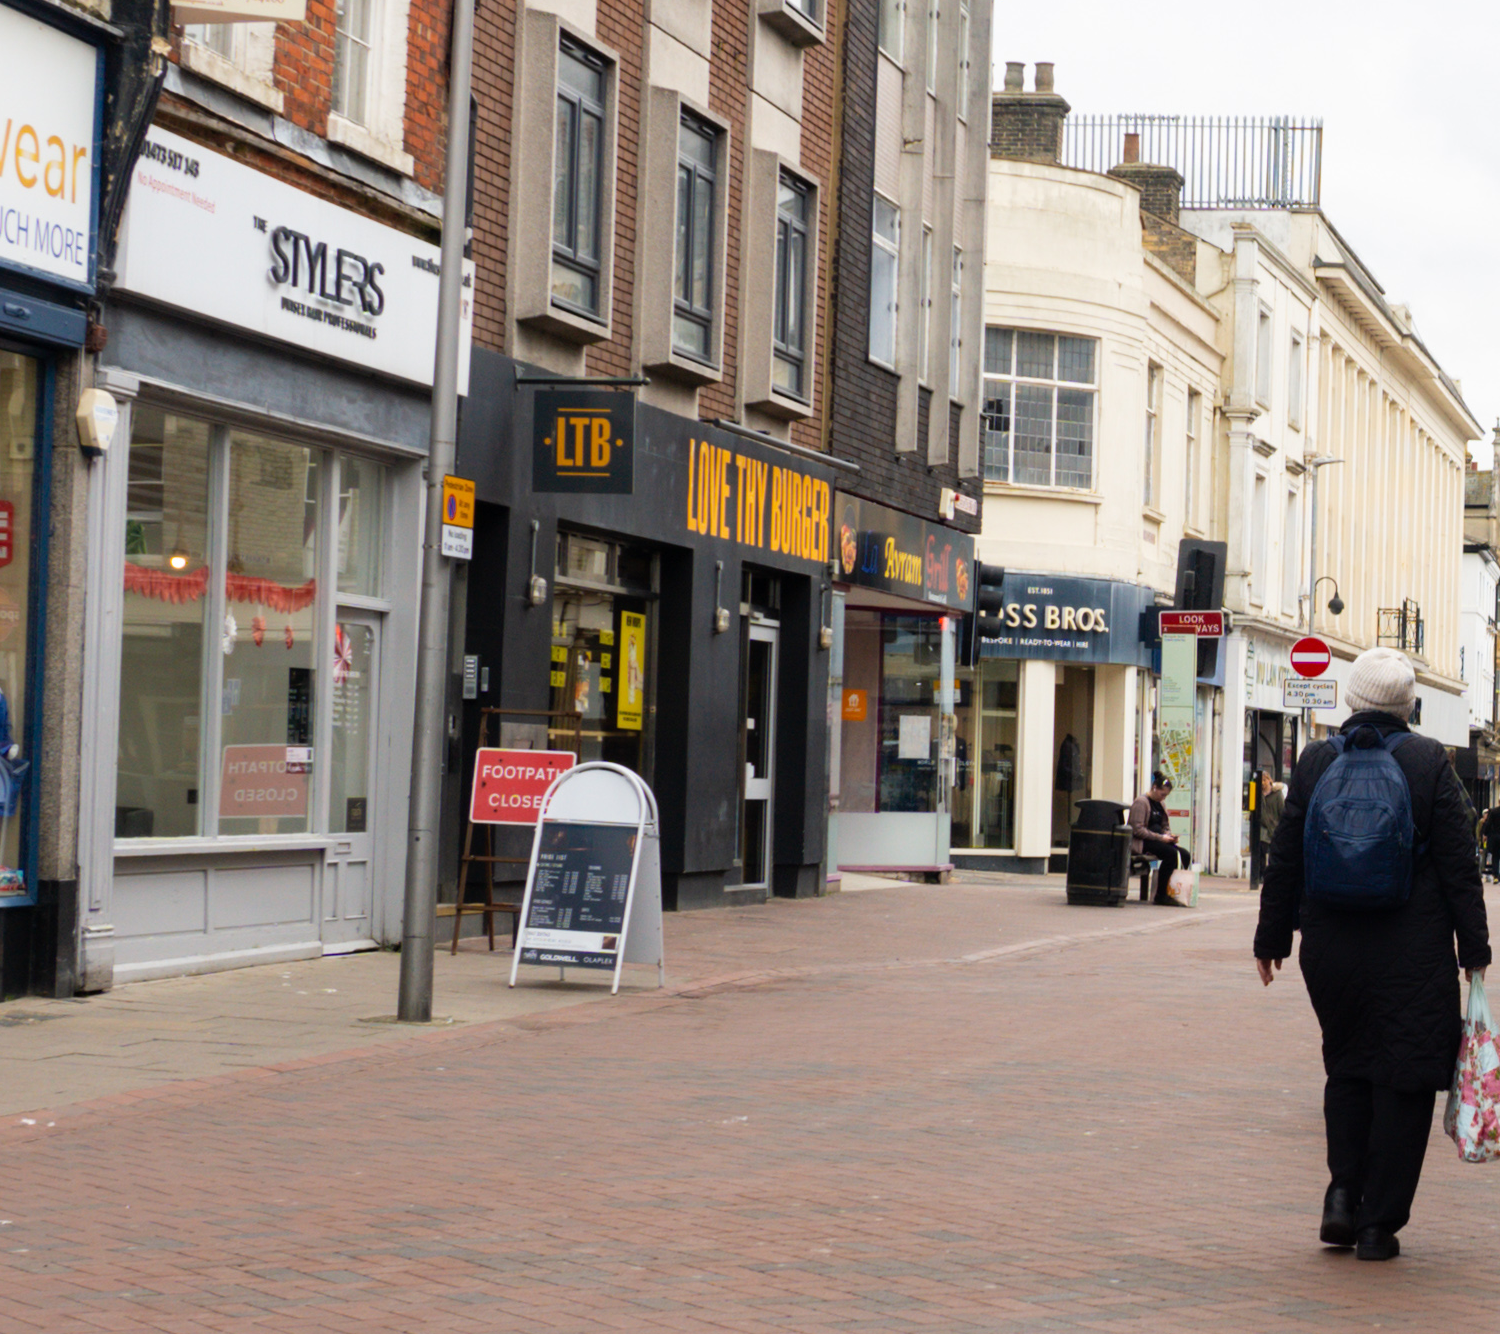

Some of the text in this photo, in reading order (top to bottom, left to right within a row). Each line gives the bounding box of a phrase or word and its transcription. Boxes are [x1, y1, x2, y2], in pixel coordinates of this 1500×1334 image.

[34, 223, 84, 265] MORE
[269, 226, 385, 316] STYLERS
[556, 417, 611, 467] LTB
[687, 438, 830, 563] LOVE THY BURGER
[861, 530, 879, 574] La
[884, 537, 922, 586] Avram
[1044, 605, 1109, 633] BROS.
[1179, 615, 1204, 624] LOOK
[1020, 638, 1071, 648] READY-TO-WEAR
[1287, 682, 1311, 690] Except
[489, 793, 546, 809] CLOSE
[583, 955, 613, 965] OLAPLEX
